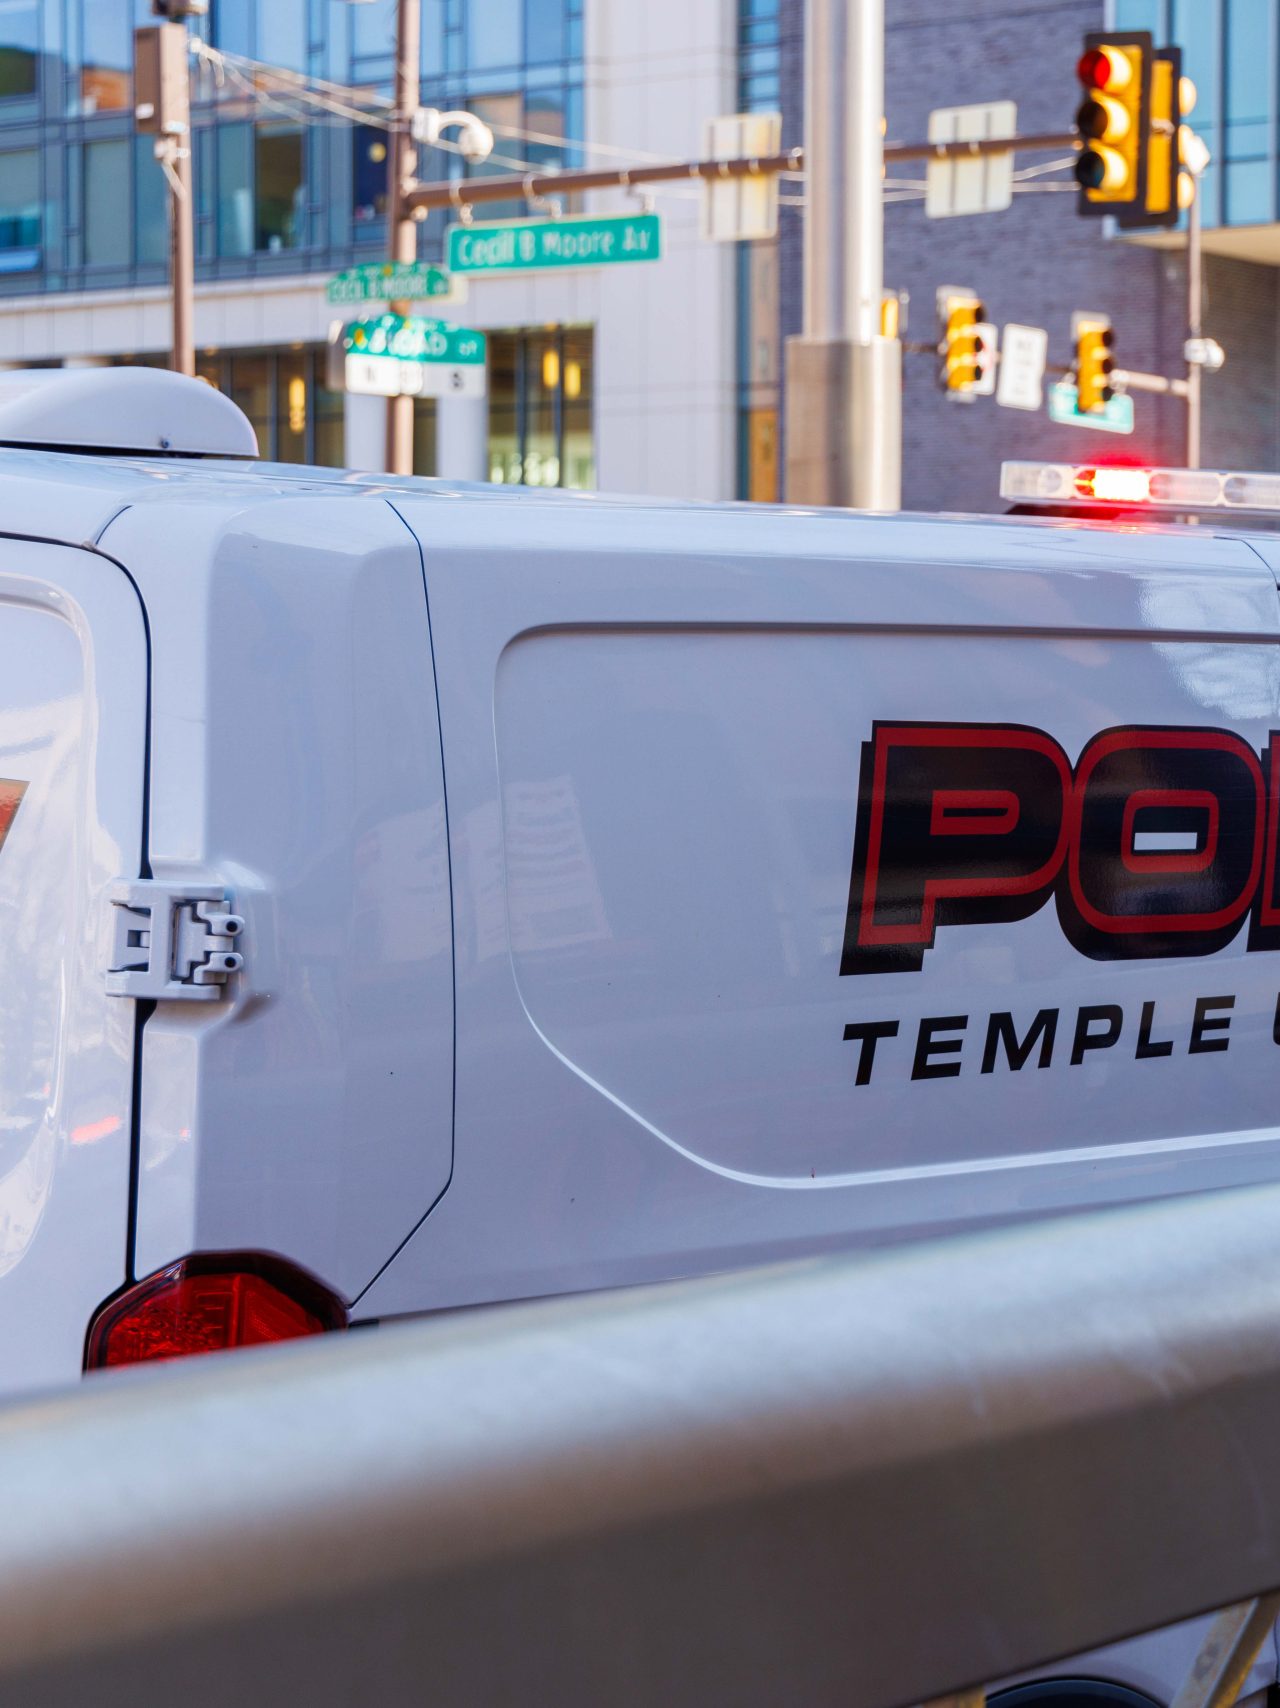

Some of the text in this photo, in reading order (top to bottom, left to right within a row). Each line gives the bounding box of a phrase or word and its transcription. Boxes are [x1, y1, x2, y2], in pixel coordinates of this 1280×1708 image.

[458, 230, 515, 266] Cecil
[519, 230, 535, 262] B
[542, 231, 614, 259] Moore
[842, 995, 1236, 1086] TEMPLE
